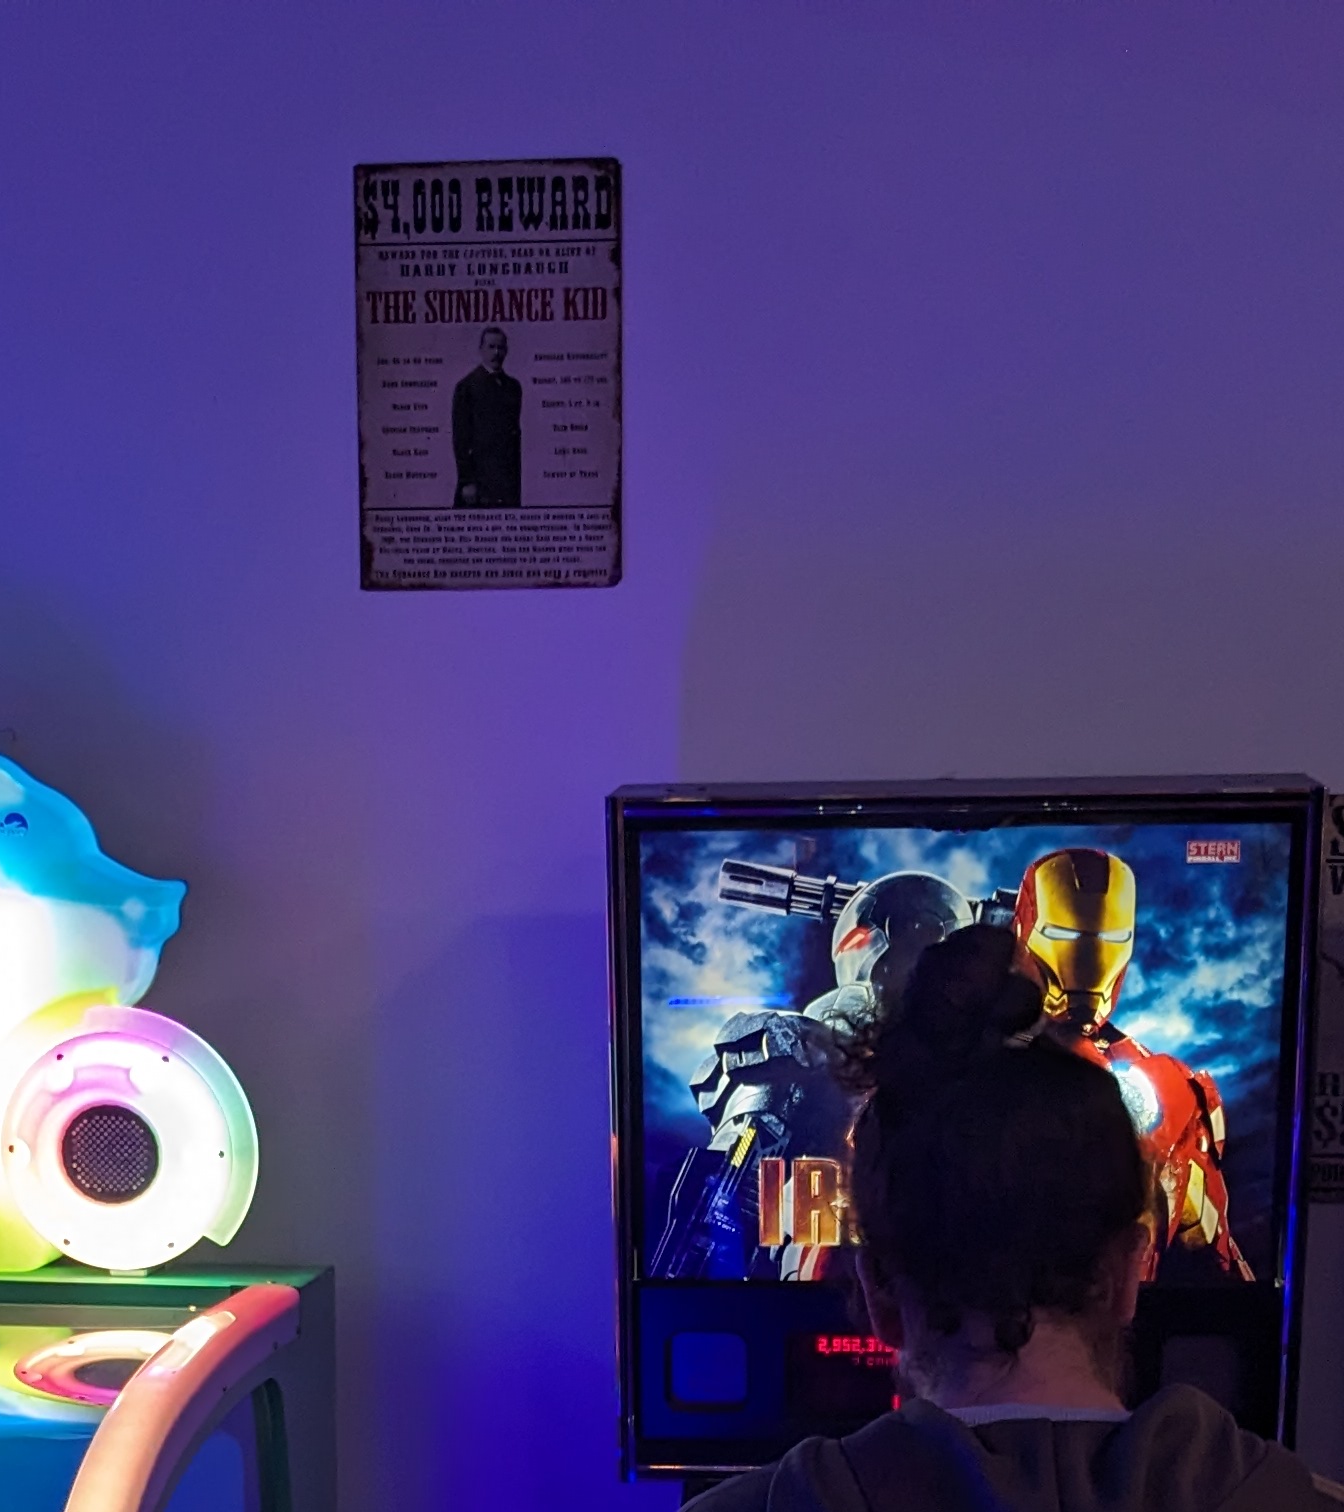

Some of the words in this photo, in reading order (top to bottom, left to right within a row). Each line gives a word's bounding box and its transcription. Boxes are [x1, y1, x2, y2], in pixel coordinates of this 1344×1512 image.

[363, 177, 462, 240] $4,000
[475, 175, 613, 232] REWARD
[366, 290, 416, 324] THE
[424, 288, 555, 324] SUNDANCE
[563, 286, 607, 321] KID
[1189, 842, 1238, 856] STERN
